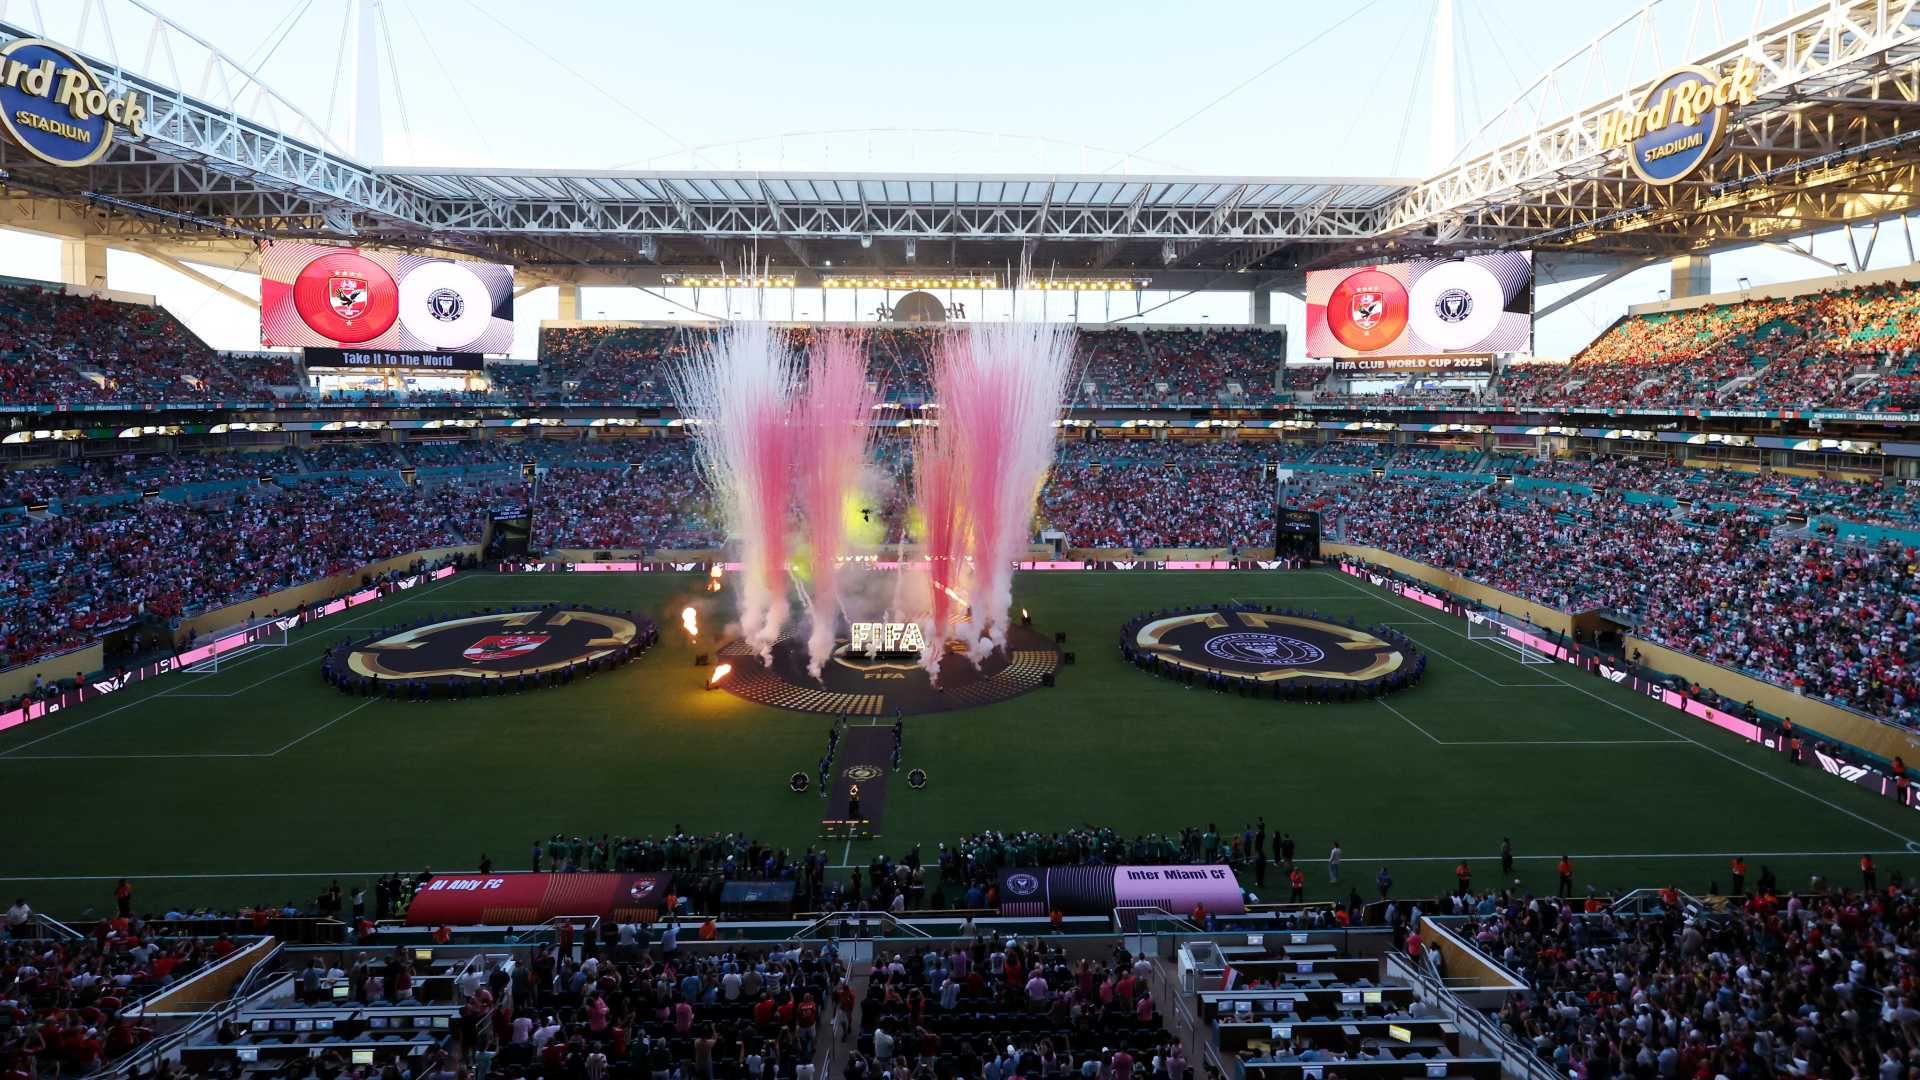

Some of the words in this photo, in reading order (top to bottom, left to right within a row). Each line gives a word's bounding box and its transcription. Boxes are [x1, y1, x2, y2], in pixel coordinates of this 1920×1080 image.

[0, 55, 56, 98] rd
[55, 68, 146, 138] Rock
[1600, 87, 1674, 150] Hard
[1671, 54, 1759, 127] Rock
[16, 111, 91, 143] STADIUM
[1644, 133, 1703, 162] STADIUM
[343, 352, 370, 365] Take
[373, 352, 381, 365] It
[384, 353, 396, 365] To
[400, 354, 419, 366] The
[423, 355, 453, 366] World
[1335, 361, 1357, 370] FIFA
[1359, 360, 1384, 369] CLUB
[1387, 359, 1425, 369] WORLD
[1428, 358, 1451, 368] CUP
[1874, 413, 1907, 421] MARINO
[851, 623, 926, 652] FIFA
[448, 878, 482, 891] Ahly
[484, 878, 504, 889] FC
[1128, 870, 1161, 881] Inter
[1164, 870, 1208, 880] Miami
[1210, 870, 1227, 880] CF
